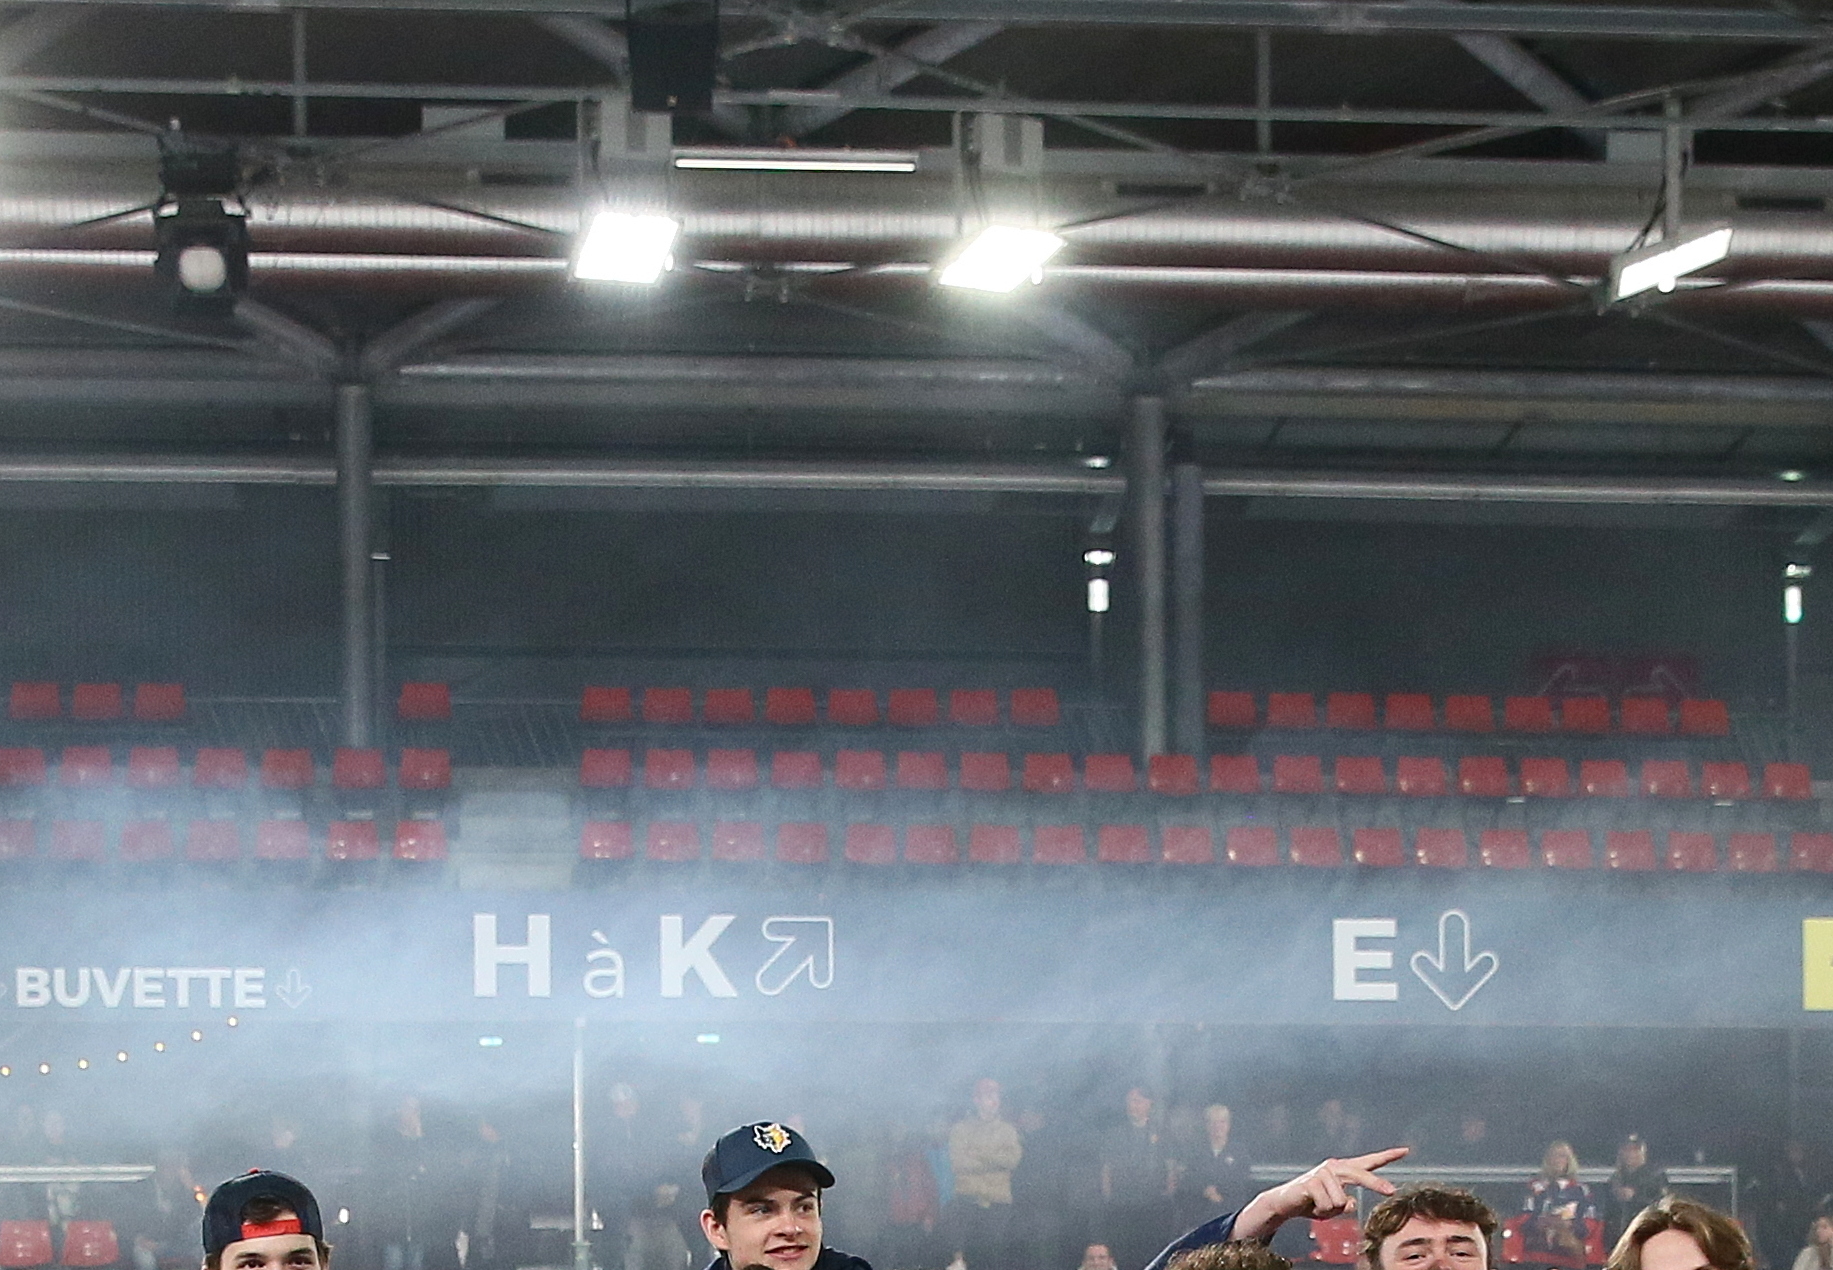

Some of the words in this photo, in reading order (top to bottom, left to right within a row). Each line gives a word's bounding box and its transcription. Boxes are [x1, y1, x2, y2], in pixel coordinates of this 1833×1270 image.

[16, 968, 266, 1010] BUVETTE
[473, 913, 552, 998] H
[585, 930, 625, 998] à
[662, 913, 739, 998] K
[1333, 918, 1397, 1000] E
